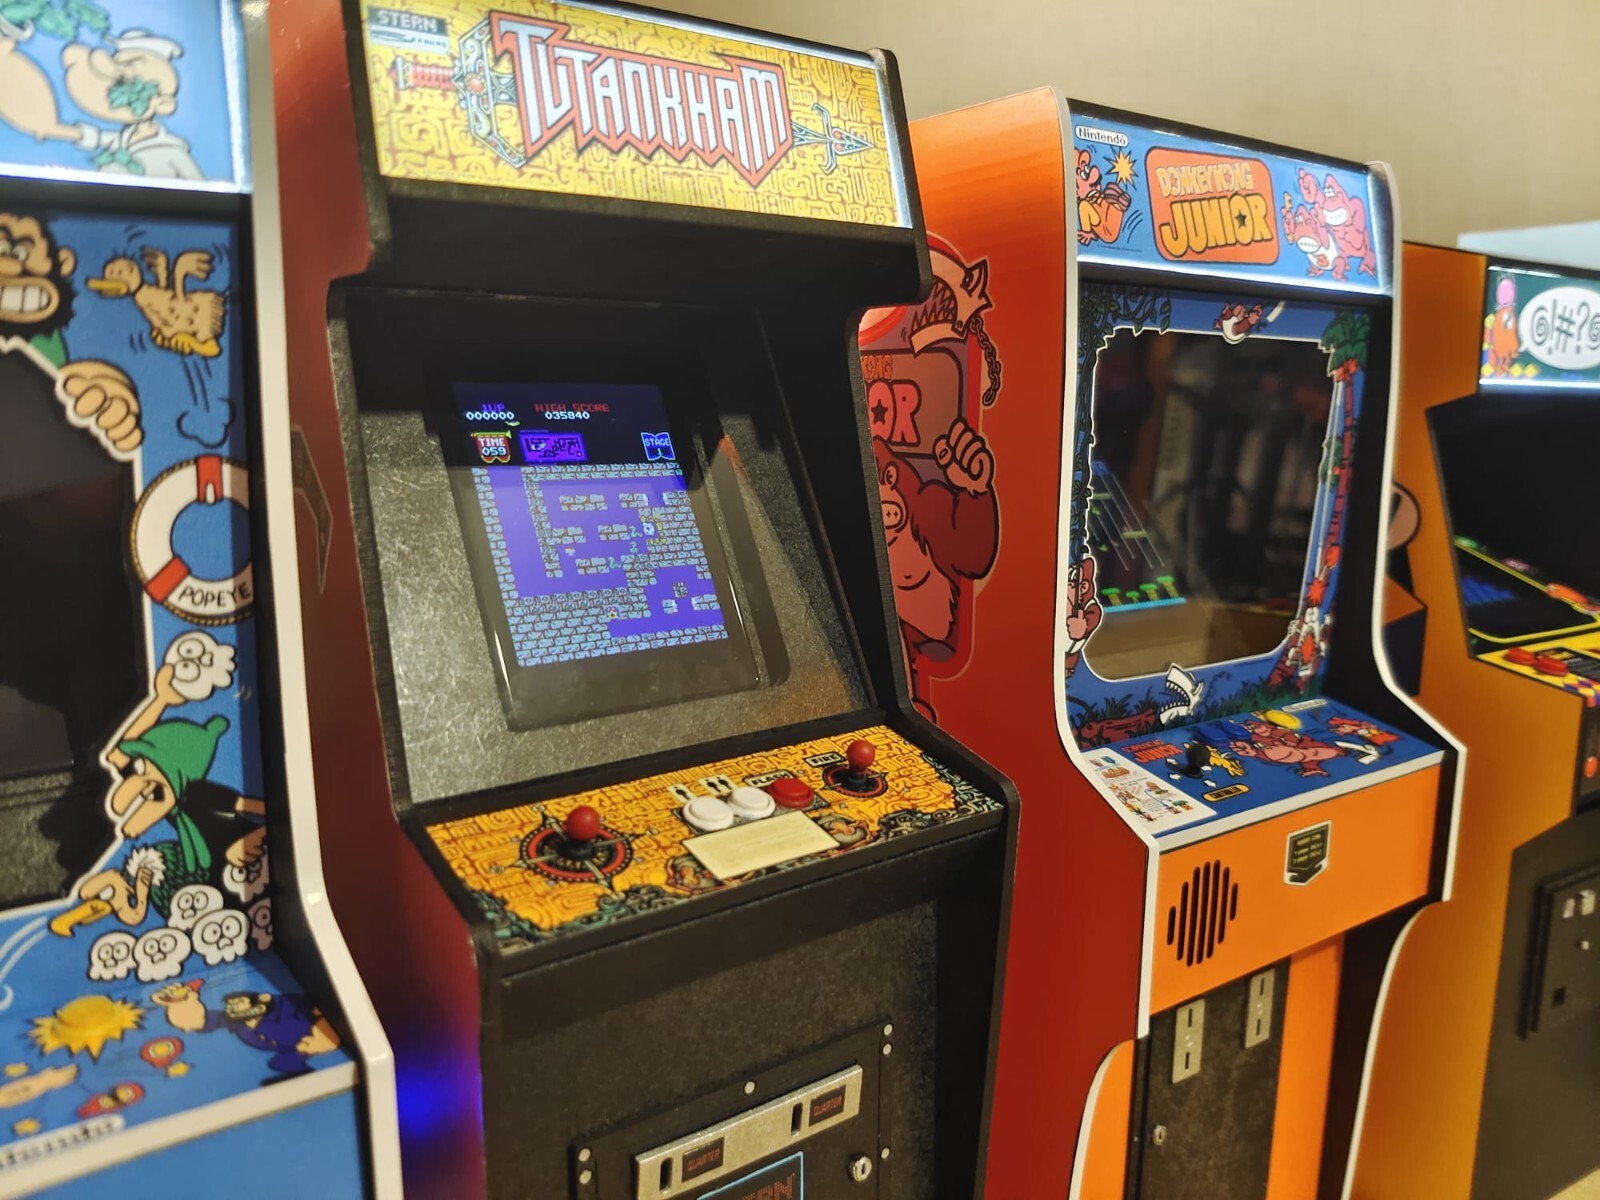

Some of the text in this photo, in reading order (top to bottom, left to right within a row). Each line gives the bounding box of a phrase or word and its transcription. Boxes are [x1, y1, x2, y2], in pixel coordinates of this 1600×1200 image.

[379, 9, 438, 33] STERN
[497, 17, 790, 175] TUTANKHAM
[1078, 126, 1127, 146] Nintendo
[1155, 162, 1254, 198] DONKEY KONG
[1159, 192, 1274, 258] JUNIOR
[466, 411, 590, 420] 000000 035840
[482, 403, 610, 412] 1UP HIGH SCORE
[478, 437, 506, 447] TIME
[482, 447, 506, 456] 059
[645, 438, 670, 447] STAGE
[178, 581, 252, 608] POPEYE
[810, 753, 840, 765] FIRE
[813, 1095, 842, 1117] QUARTER
[687, 1148, 721, 1172] QUARTER
